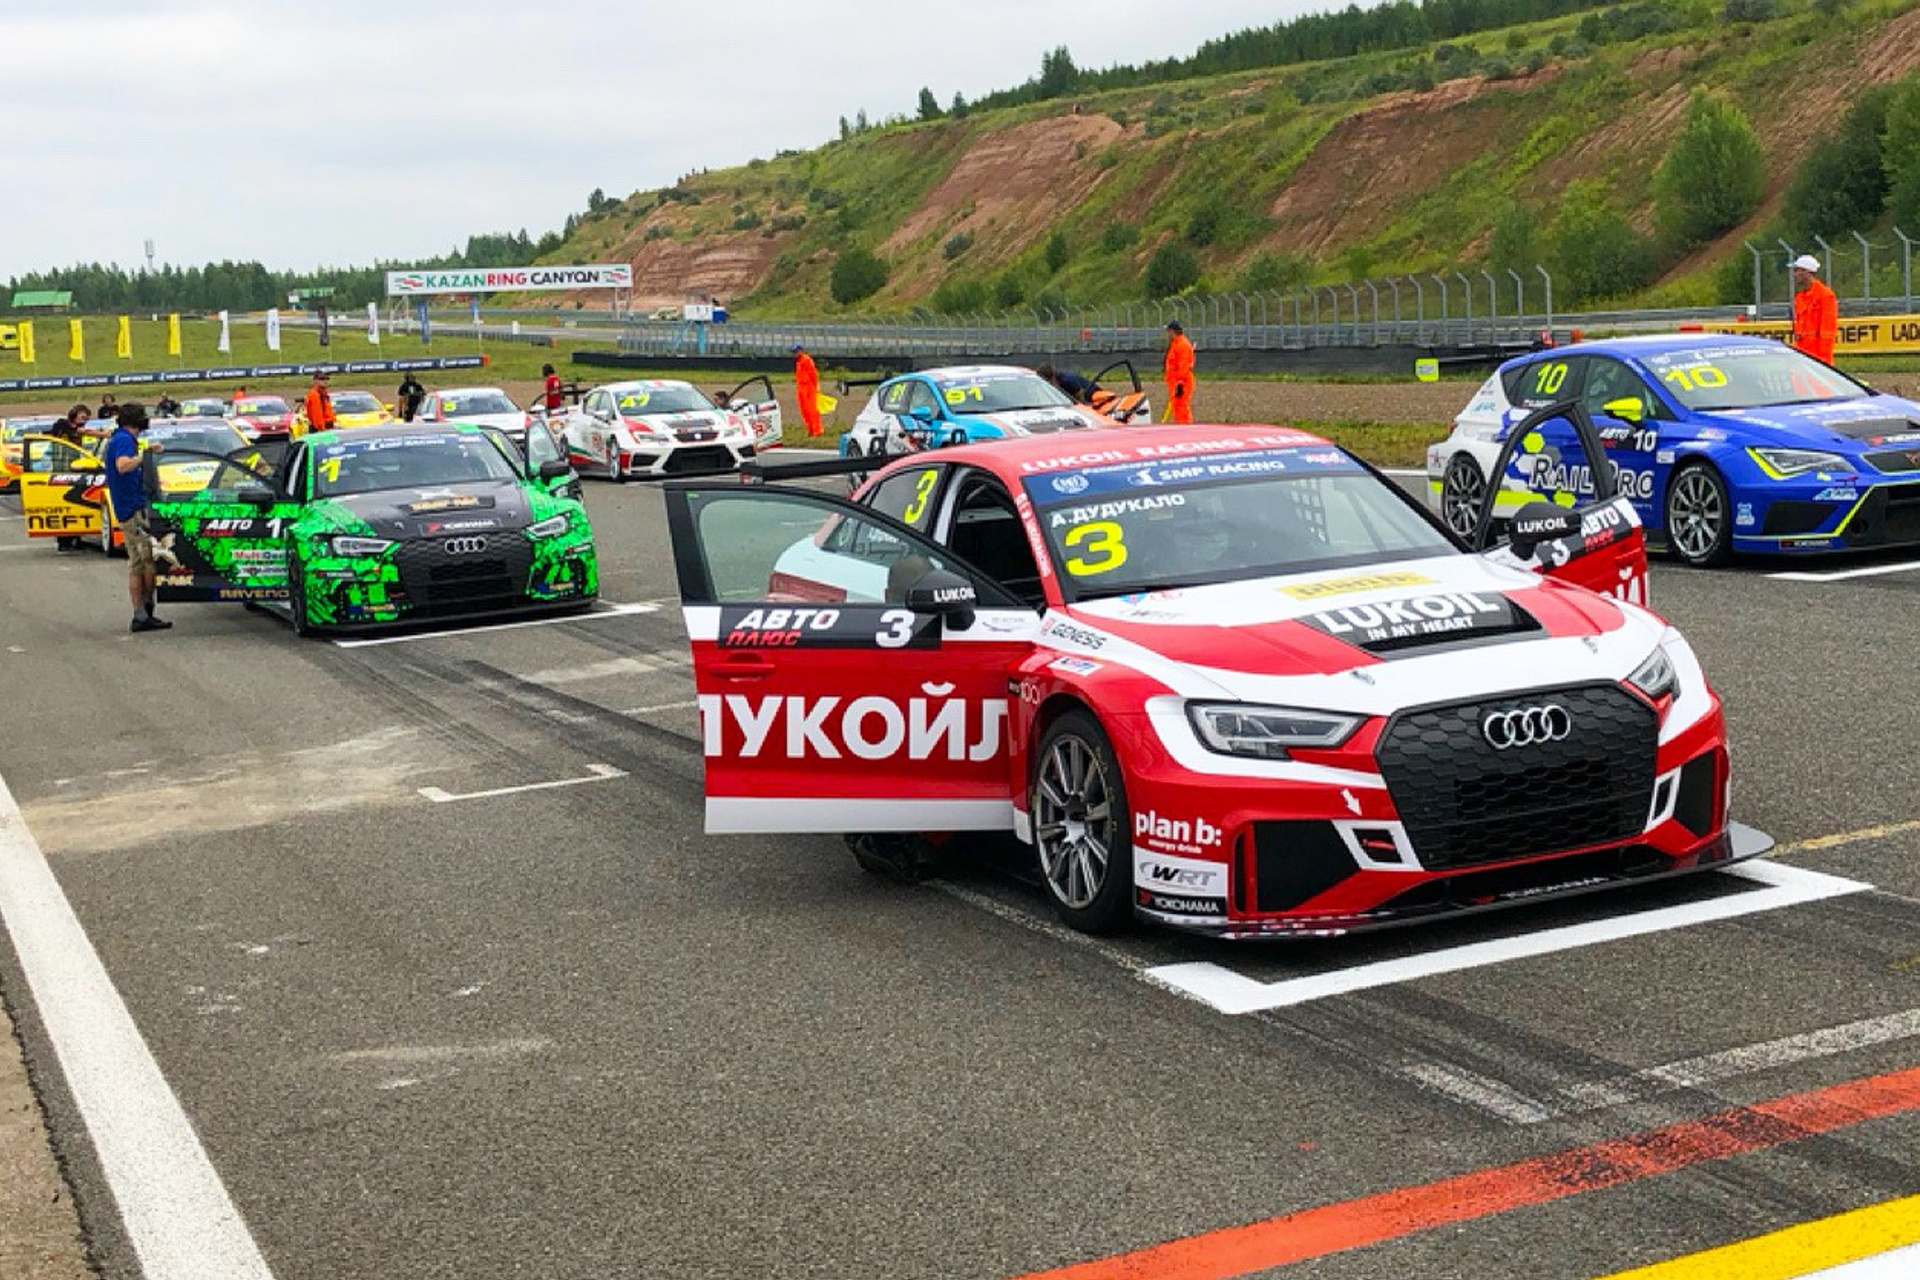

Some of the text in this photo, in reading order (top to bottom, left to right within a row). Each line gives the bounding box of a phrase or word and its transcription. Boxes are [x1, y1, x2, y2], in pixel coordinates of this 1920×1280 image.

[425, 270, 600, 288] KAZANRING CANYON
[1891, 321, 1920, 342] LAD
[1537, 362, 1567, 394] 10
[1665, 364, 1728, 391] 10
[1021, 431, 1322, 472] LUKOIL RACING TEAM
[1632, 429, 1658, 453] 10
[318, 458, 342, 482] 1
[1160, 460, 1286, 481] SMP RACING
[903, 469, 939, 524] 3
[1051, 493, 1186, 528] А.ДУДУКАЛО
[205, 518, 253, 531] АВТО
[265, 517, 282, 538] 1
[1517, 516, 1568, 534] LUKOIL
[1064, 520, 1128, 576] 3
[932, 586, 977, 603] LUKOIL
[733, 608, 840, 630] АВТО
[1312, 590, 1502, 633] LUKOIL
[725, 630, 802, 647] ПЛЮС
[875, 608, 916, 648] 3
[1366, 616, 1474, 642] IN MY HEART
[1135, 810, 1223, 847] plan b:
[1151, 864, 1217, 886] WRT
[1153, 896, 1220, 913] YOKOHAMA
